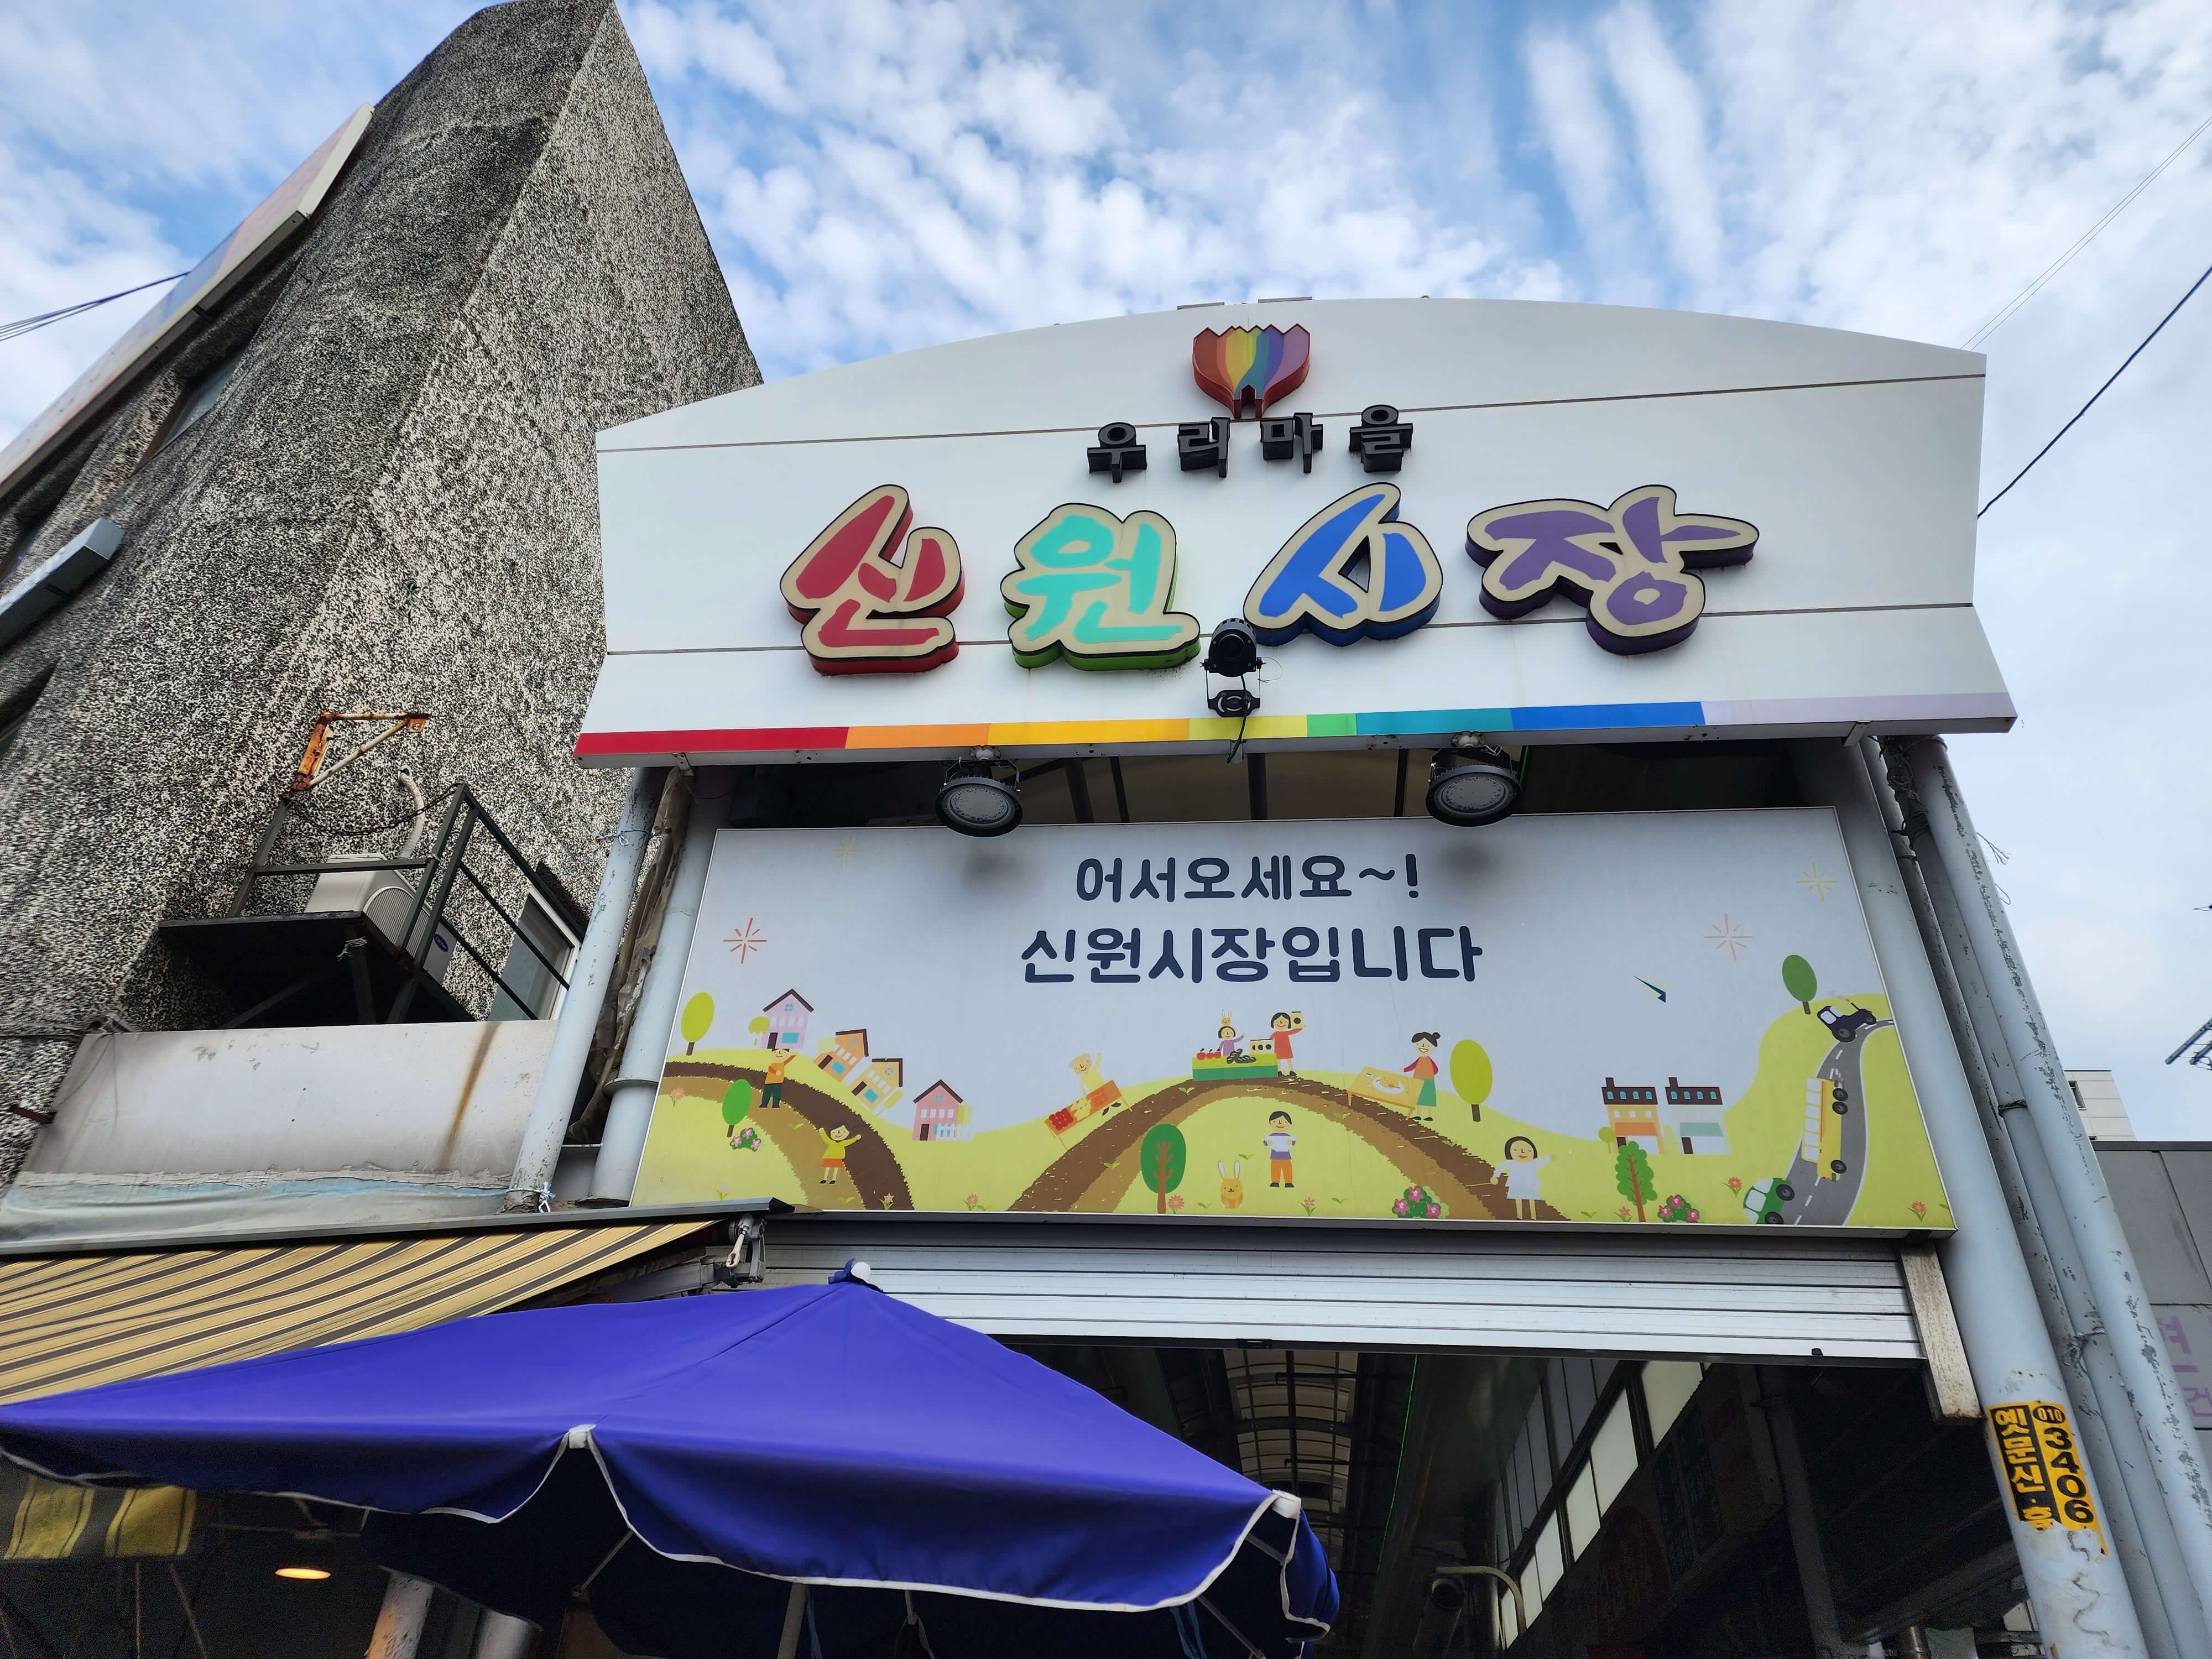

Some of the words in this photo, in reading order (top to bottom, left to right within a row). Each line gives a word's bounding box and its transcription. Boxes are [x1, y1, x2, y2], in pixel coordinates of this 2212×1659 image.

[1087, 404, 1413, 483] 우리마을
[780, 484, 1760, 664] 신원시장
[1076, 853, 1419, 903] 어서오세요~!
[1021, 926, 1483, 984] 신원시장입니다
[2038, 1407, 2063, 1422] 010
[2043, 1427, 2094, 1524] 3406
